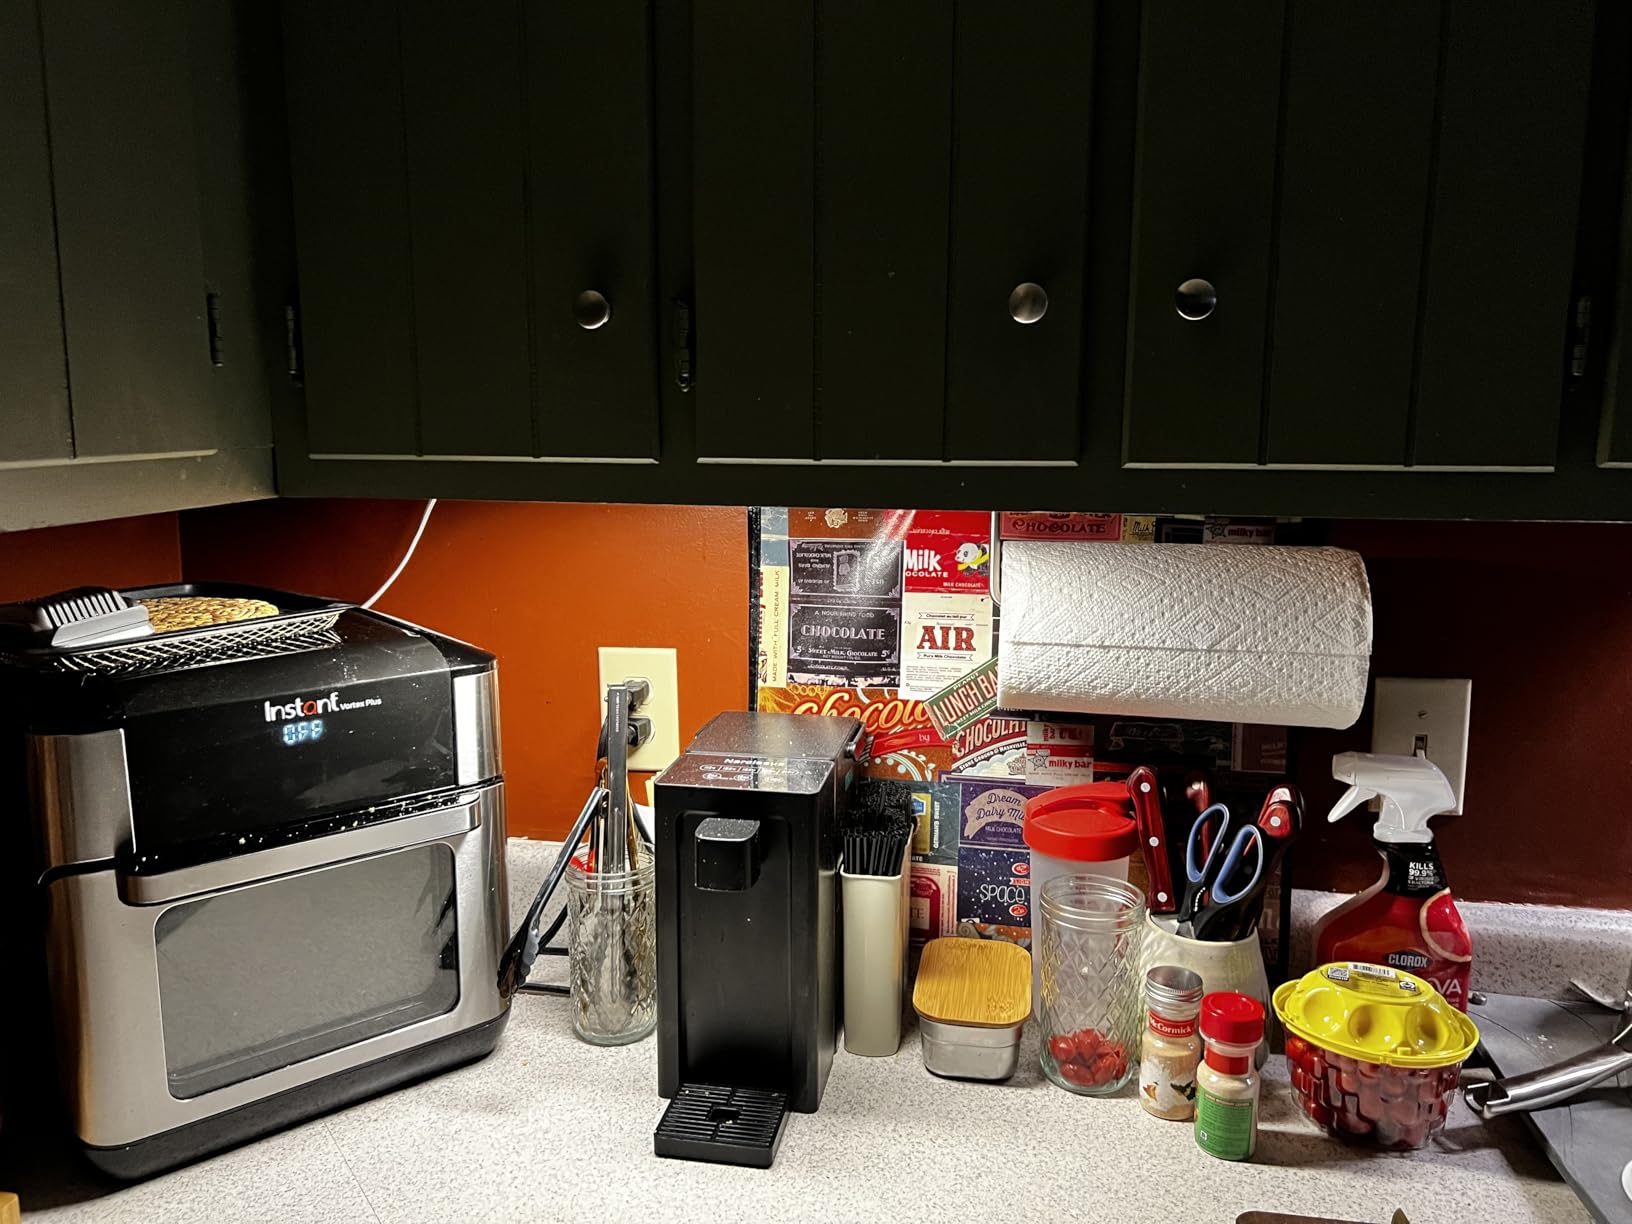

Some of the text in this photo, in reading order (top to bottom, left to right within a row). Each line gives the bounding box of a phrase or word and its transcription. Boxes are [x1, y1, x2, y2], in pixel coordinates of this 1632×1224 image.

[1012, 520, 1106, 533] CHOCOLATE
[1228, 527, 1254, 538] milky
[905, 549, 942, 571] Milk
[800, 624, 886, 640] CHOCOLATE
[916, 625, 976, 651] AIR
[846, 649, 878, 657] CHOCOLATE
[953, 672, 979, 690] PEANUT
[933, 681, 983, 727] LUNCH
[977, 666, 998, 698] BA
[264, 692, 382, 722] Instant Vortex Plus
[283, 720, 324, 745] OFF
[918, 733, 930, 743] by
[1049, 759, 1092, 769] milky bar
[987, 792, 1022, 806] Dream
[976, 807, 1025, 821] Dairy Mi
[1408, 861, 1434, 870] KILLS
[1408, 868, 1434, 877] 99.9%
[1388, 953, 1428, 968] CLOROX
[1150, 1017, 1191, 1034] McCormick
